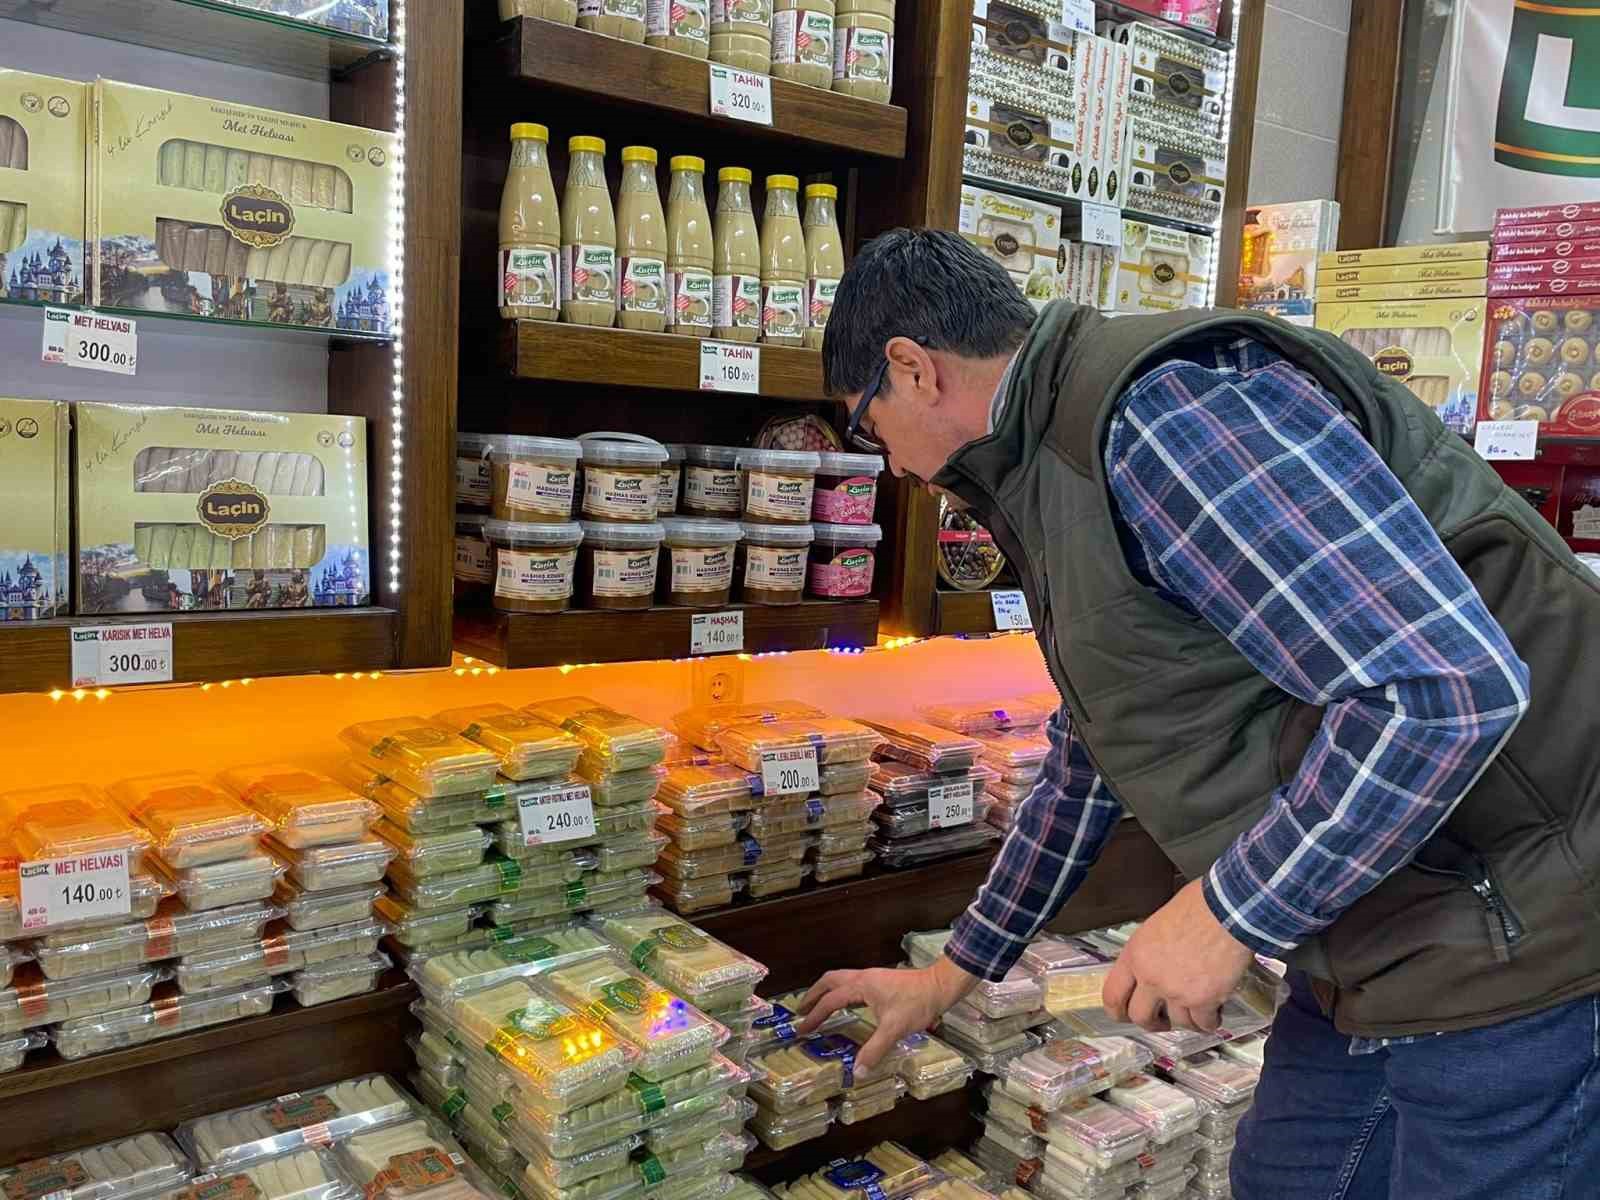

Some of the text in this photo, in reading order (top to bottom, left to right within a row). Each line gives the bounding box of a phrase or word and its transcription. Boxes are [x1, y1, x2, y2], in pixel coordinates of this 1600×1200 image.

[732, 73, 764, 88] TAHİN
[231, 204, 285, 225] Laçin
[74, 315, 92, 328] MET
[94, 317, 130, 334] HELVASI
[79, 340, 126, 365] 300.00
[721, 347, 753, 360] TAHİN
[1376, 360, 1408, 372] Laçin
[207, 501, 260, 518] Laçin
[132, 628, 146, 640] MET
[148, 627, 171, 640] HELVA
[109, 654, 157, 673] 300.00
[804, 749, 816, 760] MET
[55, 860, 77, 875] MET
[80, 854, 124, 873] HELVASI
[62, 883, 113, 905] 140.00
